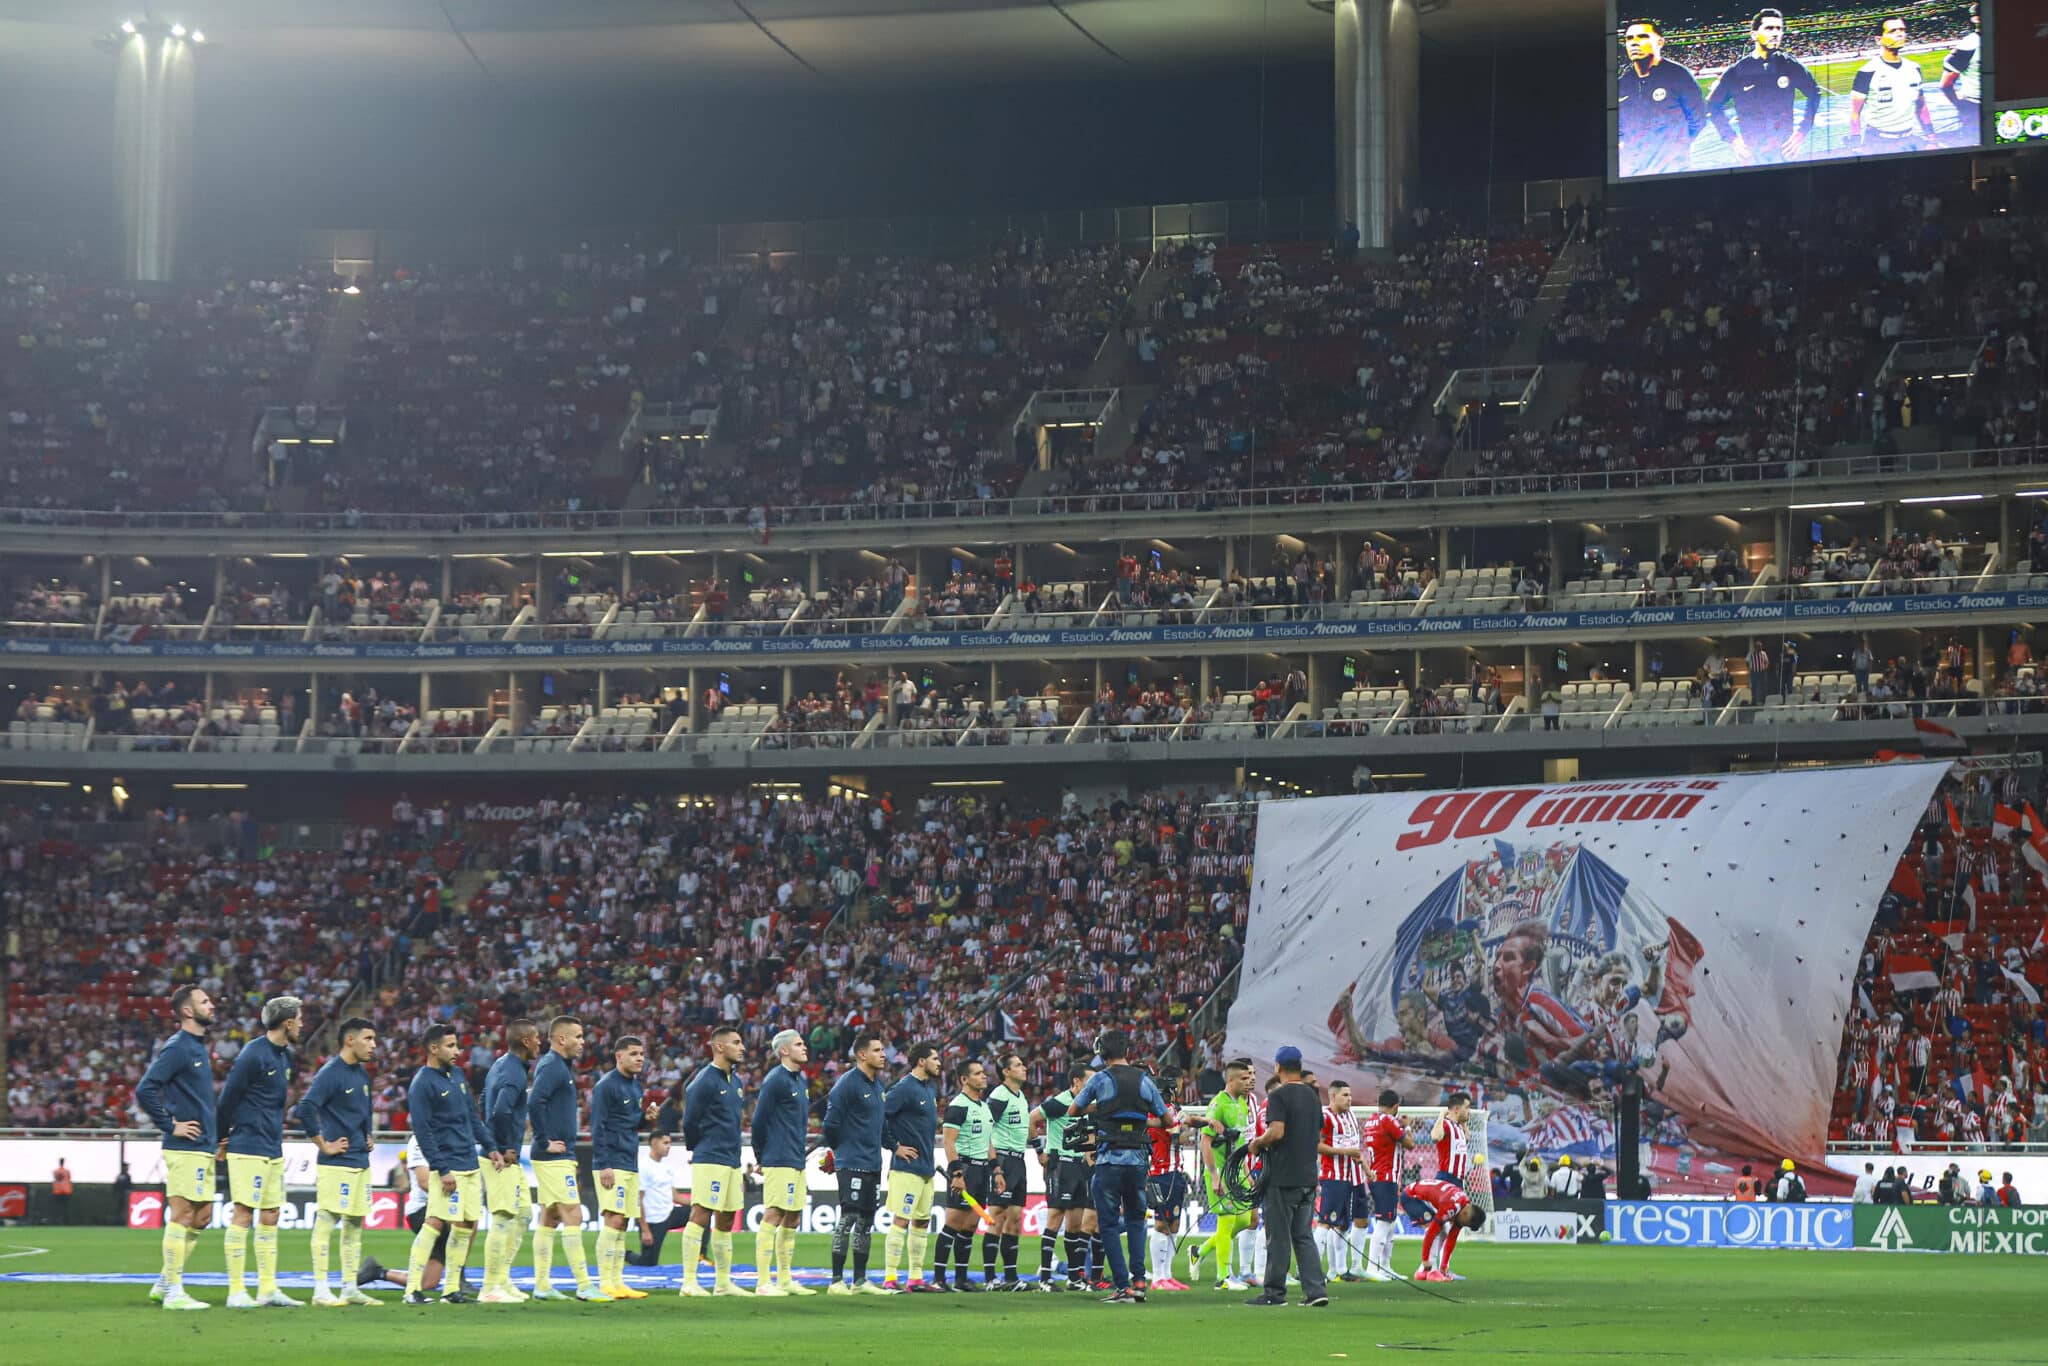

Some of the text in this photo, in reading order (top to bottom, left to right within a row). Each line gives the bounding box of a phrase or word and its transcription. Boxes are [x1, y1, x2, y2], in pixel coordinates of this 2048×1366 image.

[1794, 604, 1840, 616] Estadio
[1905, 599, 1951, 611] Estadio
[1579, 614, 1624, 626] Estadio
[1686, 609, 1731, 621] Estadio
[1368, 622, 1411, 633] Estadio
[1473, 618, 1517, 629] Estadio
[1163, 629, 1206, 640] Estadio
[1265, 625, 1308, 636] Estadio
[961, 635, 1002, 645] Estadio
[1061, 632, 1103, 642] Estadio
[663, 642, 704, 652] Estadio
[763, 640, 804, 650] Estadio
[861, 638, 901, 648] Estadio
[466, 645, 505, 655] Estadio
[564, 644, 605, 654] Estadio
[1396, 789, 1543, 851] 90
[1949, 1207, 2000, 1228] CAJA
[1509, 1225, 1551, 1239] BBVA
[1950, 1230, 2048, 1255] MEXIC
